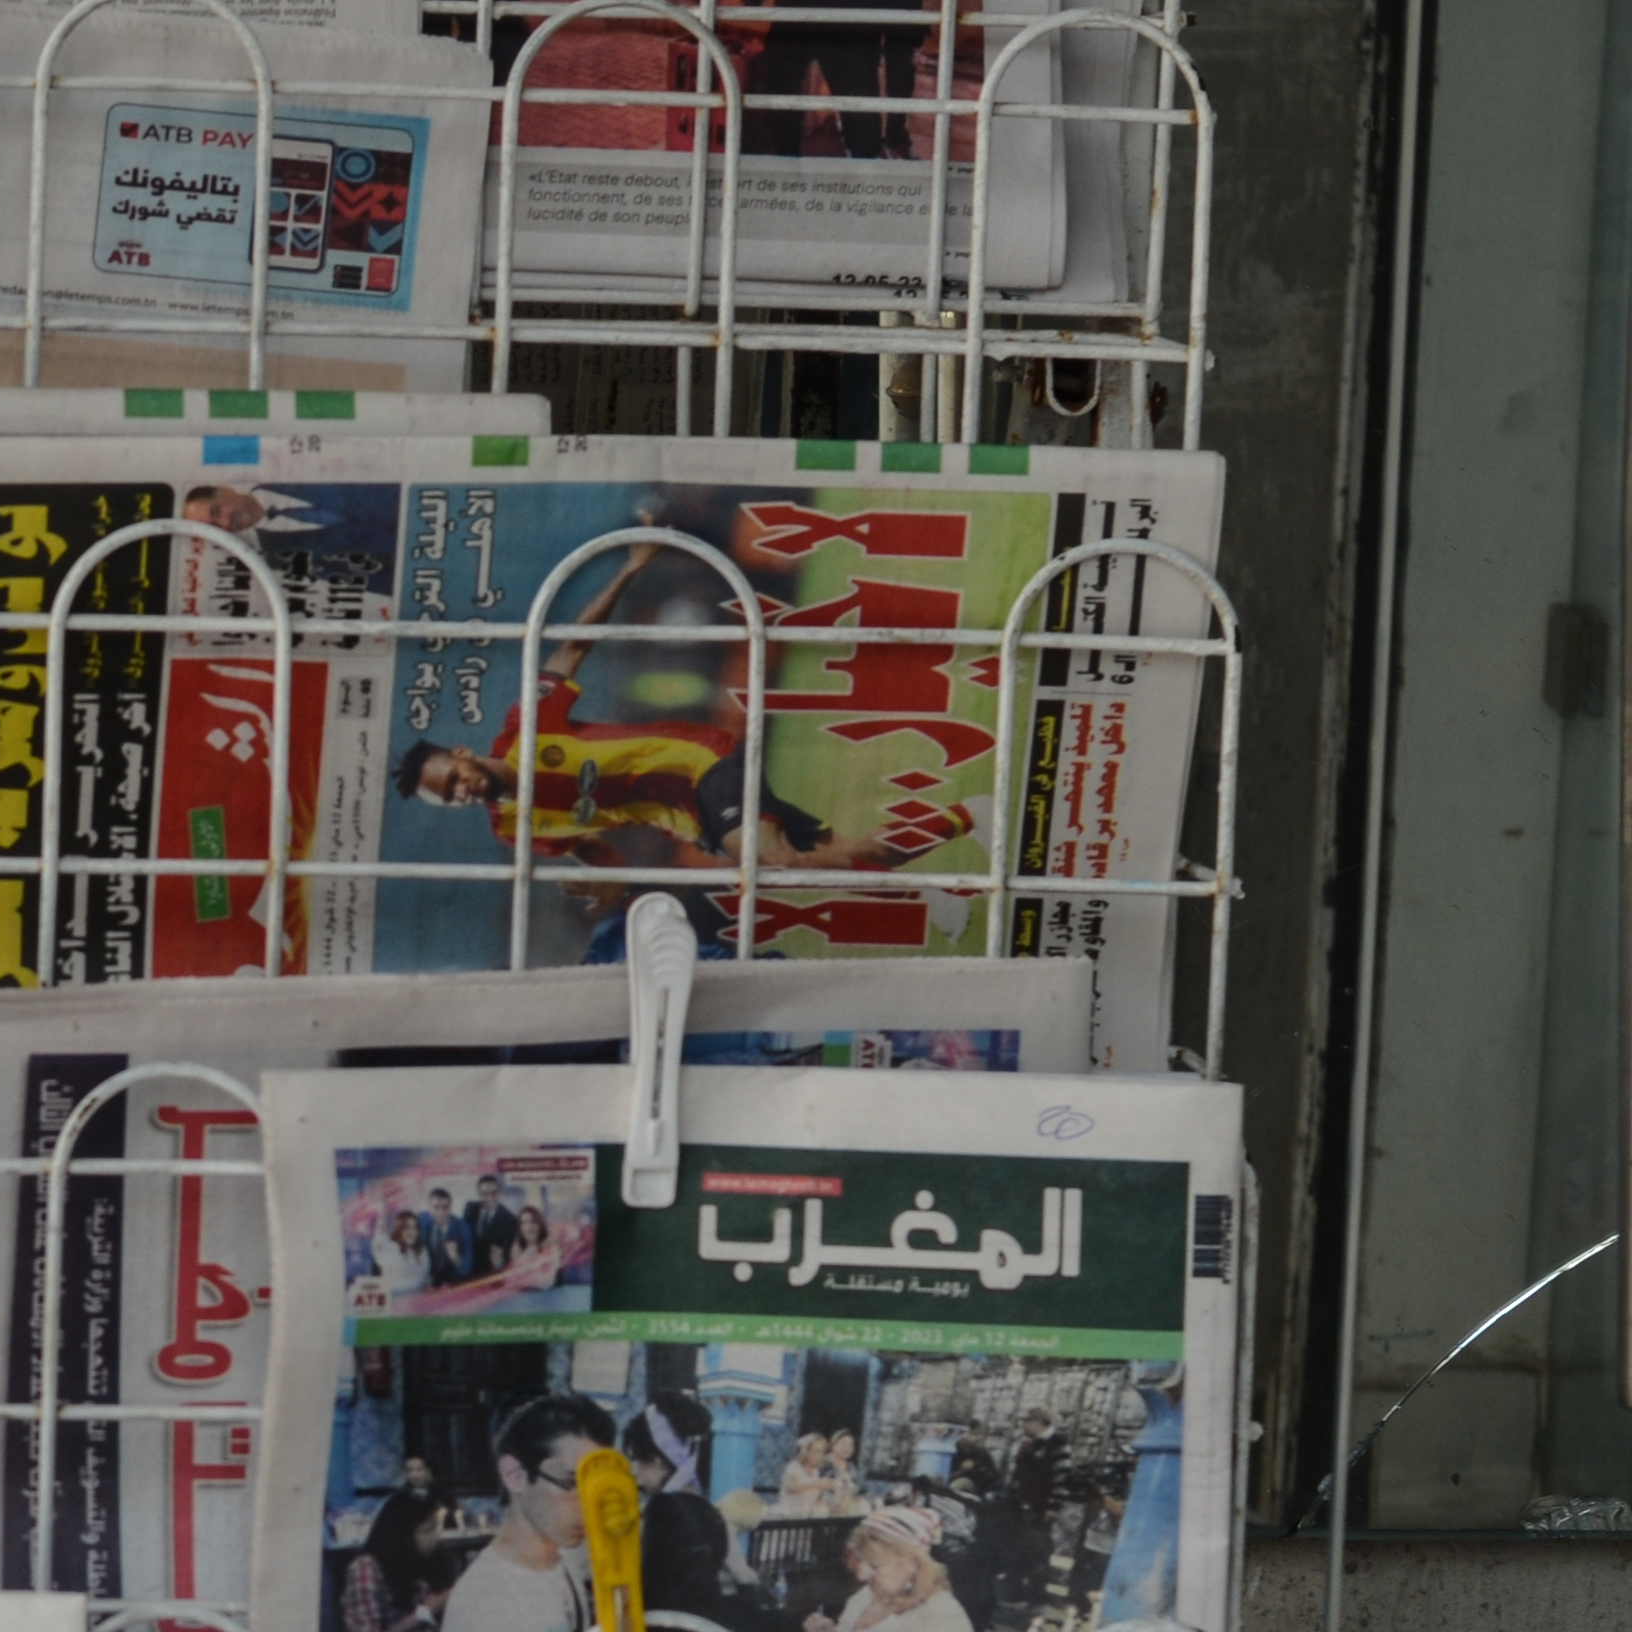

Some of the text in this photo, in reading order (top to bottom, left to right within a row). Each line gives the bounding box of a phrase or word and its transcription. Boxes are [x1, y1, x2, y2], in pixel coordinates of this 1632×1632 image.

[142, 124, 255, 150] ATB PAY
[114, 167, 241, 204] بتاليفونك
[111, 199, 238, 231] تقضي شورك
[107, 250, 152, 267] ATB
[404, 488, 458, 732] الليلة يواجه
[698, 1185, 1084, 1291] المغرب
